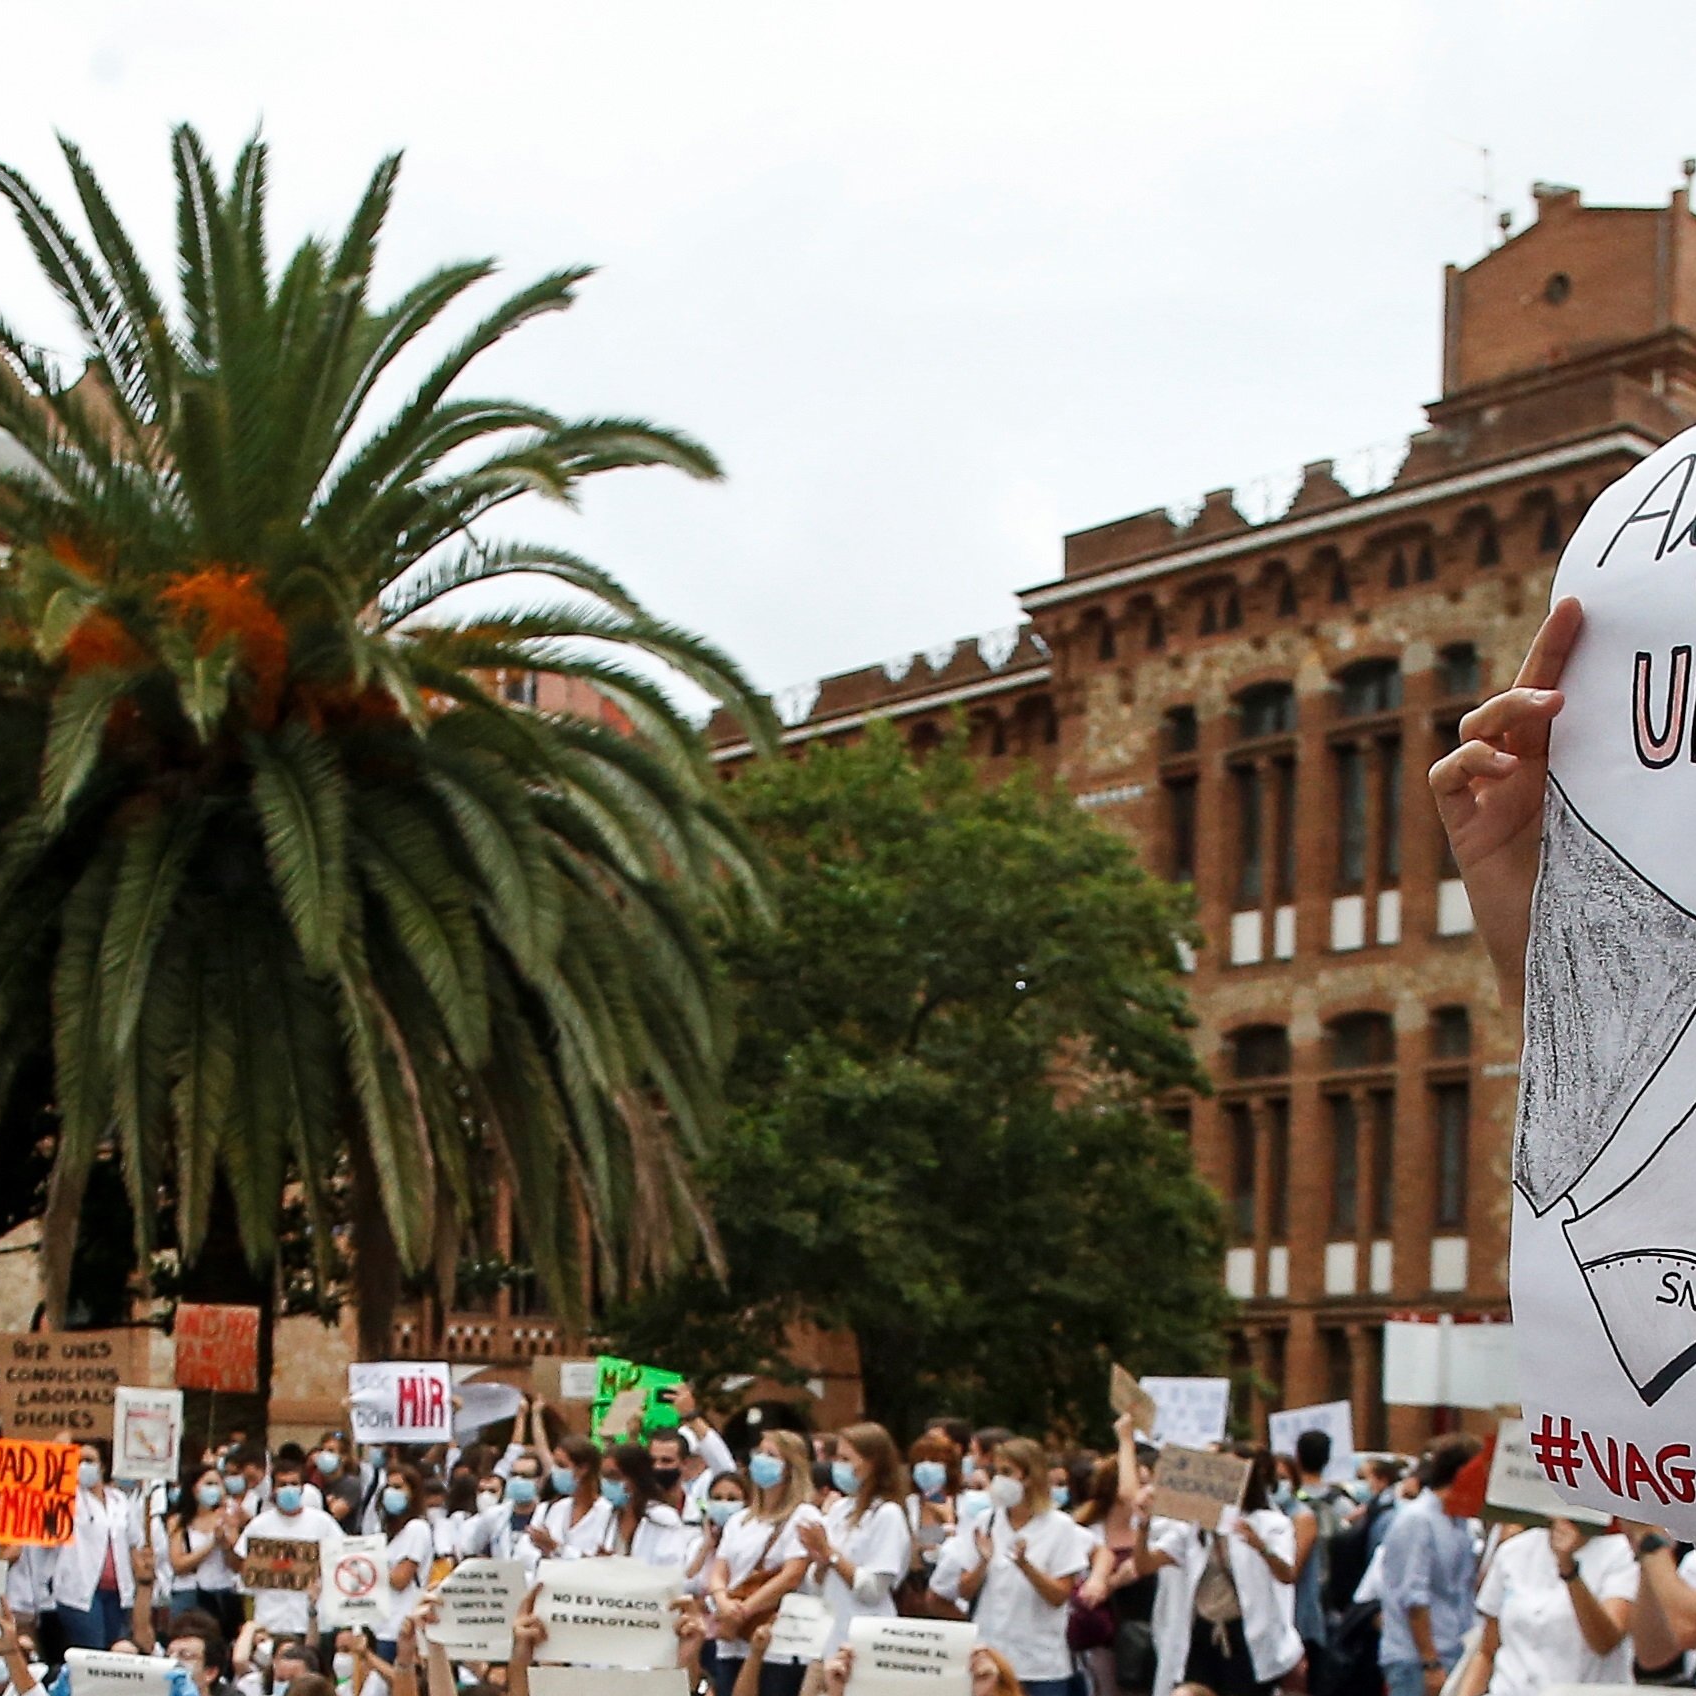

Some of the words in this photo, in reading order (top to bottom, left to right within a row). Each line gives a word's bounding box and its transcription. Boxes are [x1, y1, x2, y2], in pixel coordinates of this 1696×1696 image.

[62, 1341, 112, 1360] UNES
[6, 1367, 120, 1384] CONDICIONS
[398, 1368, 444, 1428] MIR
[14, 1410, 95, 1430] DIGNES
[44, 1449, 76, 1493] DE
[552, 1593, 572, 1605] NO
[575, 1594, 593, 1606] ES
[551, 1612, 568, 1624] ES
